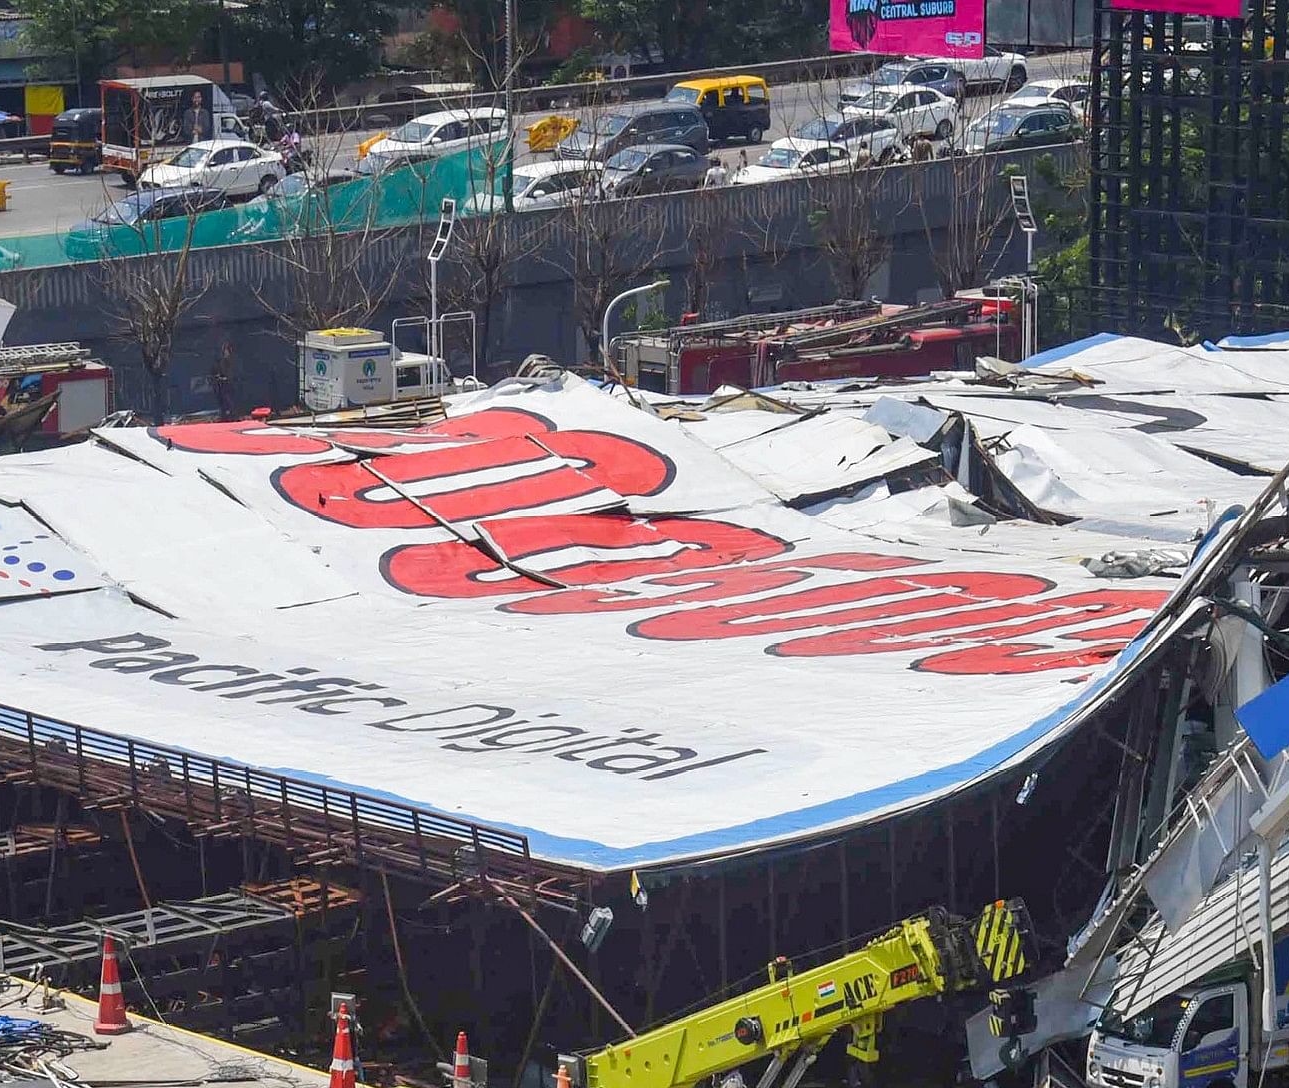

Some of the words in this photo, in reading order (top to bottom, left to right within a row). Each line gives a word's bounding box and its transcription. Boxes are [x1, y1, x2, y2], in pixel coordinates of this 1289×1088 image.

[880, 4, 918, 19] CENTRAL
[920, 1, 954, 16] SUBURB
[34, 632, 408, 715] Pacific
[364, 703, 768, 781] Digital
[843, 973, 878, 1009] ACE
